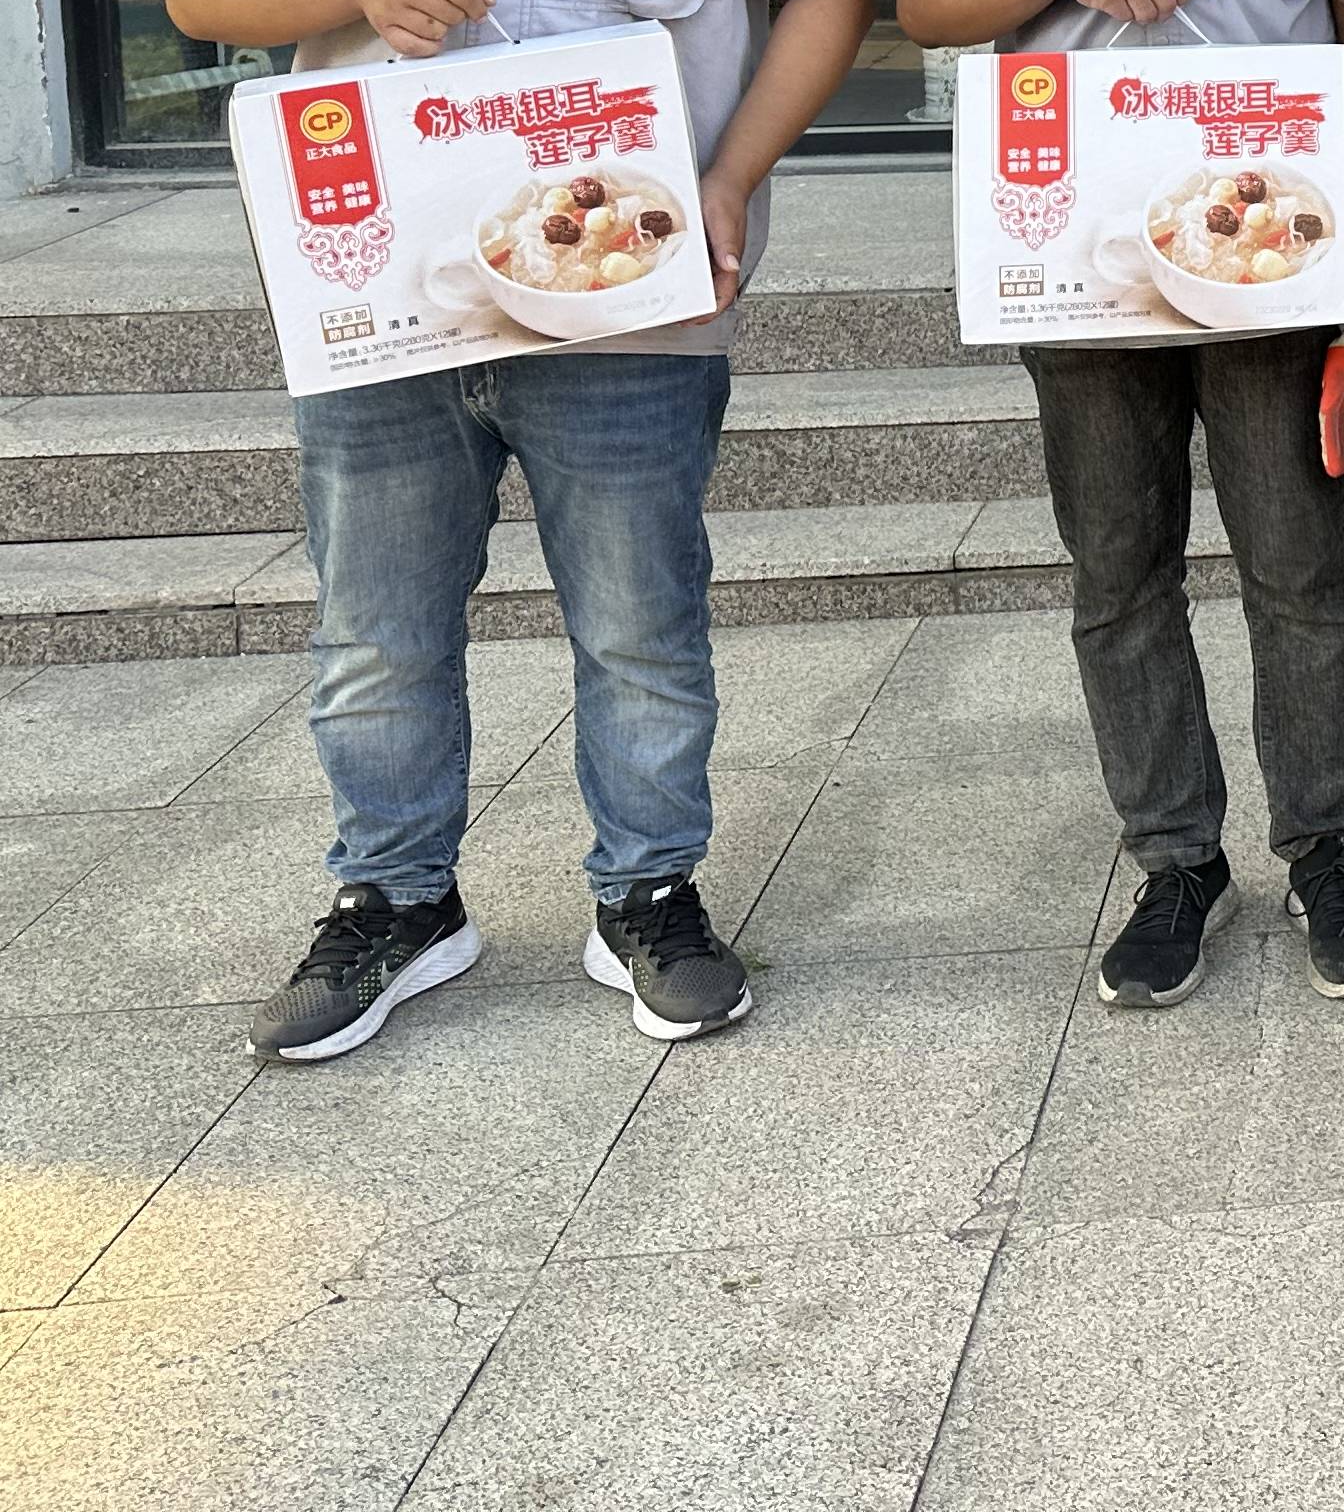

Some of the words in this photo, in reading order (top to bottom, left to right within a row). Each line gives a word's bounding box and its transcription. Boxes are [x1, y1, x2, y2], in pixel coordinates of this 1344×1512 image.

[1019, 78, 1049, 95] CP
[1124, 80, 1278, 118] 冰糖银耳
[307, 112, 342, 132] CP
[430, 82, 600, 139] 冰糖银耳
[1012, 108, 1056, 121] 正大食品
[306, 144, 357, 161] 正大食品
[530, 118, 655, 168] 莲子羹
[1204, 121, 1319, 159] 莲子羹
